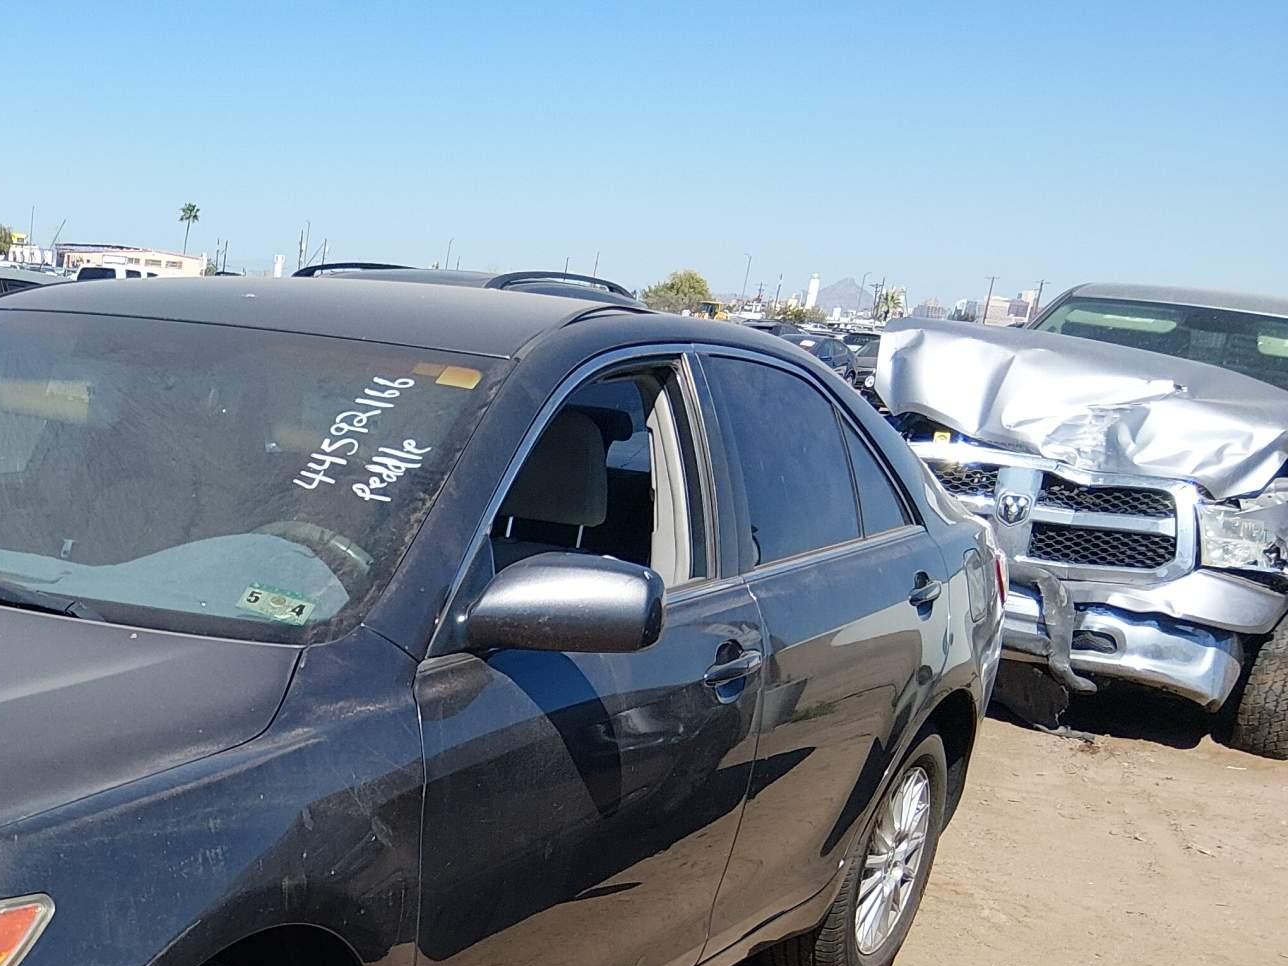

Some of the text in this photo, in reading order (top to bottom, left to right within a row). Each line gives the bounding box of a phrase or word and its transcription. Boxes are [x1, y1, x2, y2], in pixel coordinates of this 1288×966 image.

[292, 375, 415, 490] 44592166
[246, 590, 306, 617] 5 4
